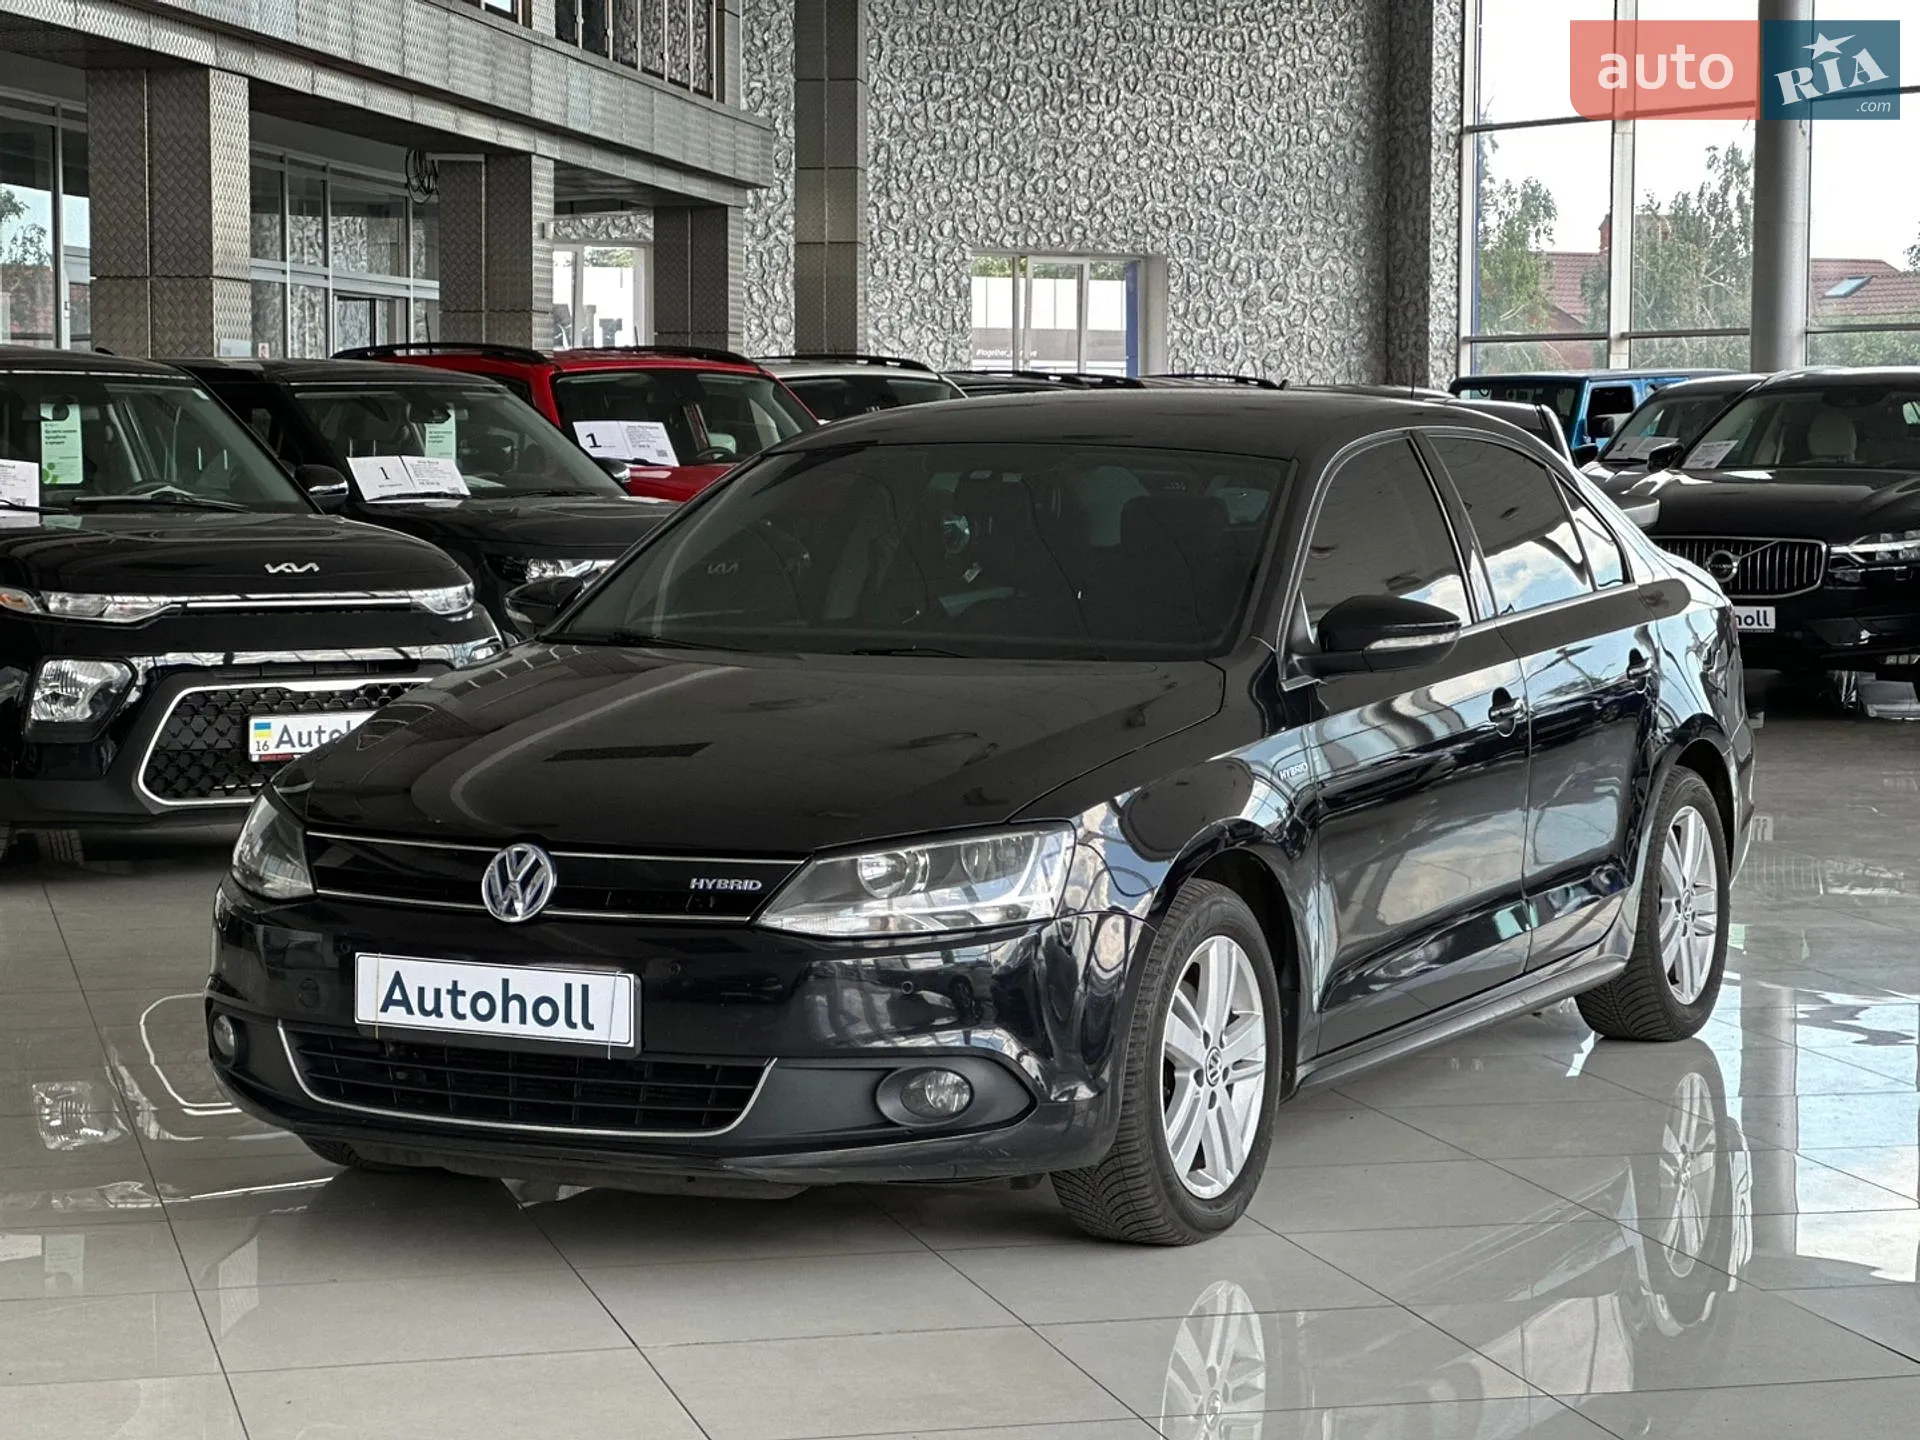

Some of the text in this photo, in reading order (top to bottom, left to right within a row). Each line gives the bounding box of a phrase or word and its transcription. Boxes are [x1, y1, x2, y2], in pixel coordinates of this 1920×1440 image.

[585, 432, 602, 449] 1
[378, 466, 390, 480] 1
[255, 740, 270, 752] 16
[689, 878, 763, 891] HYBRID
[379, 970, 595, 1031] Autoholl
